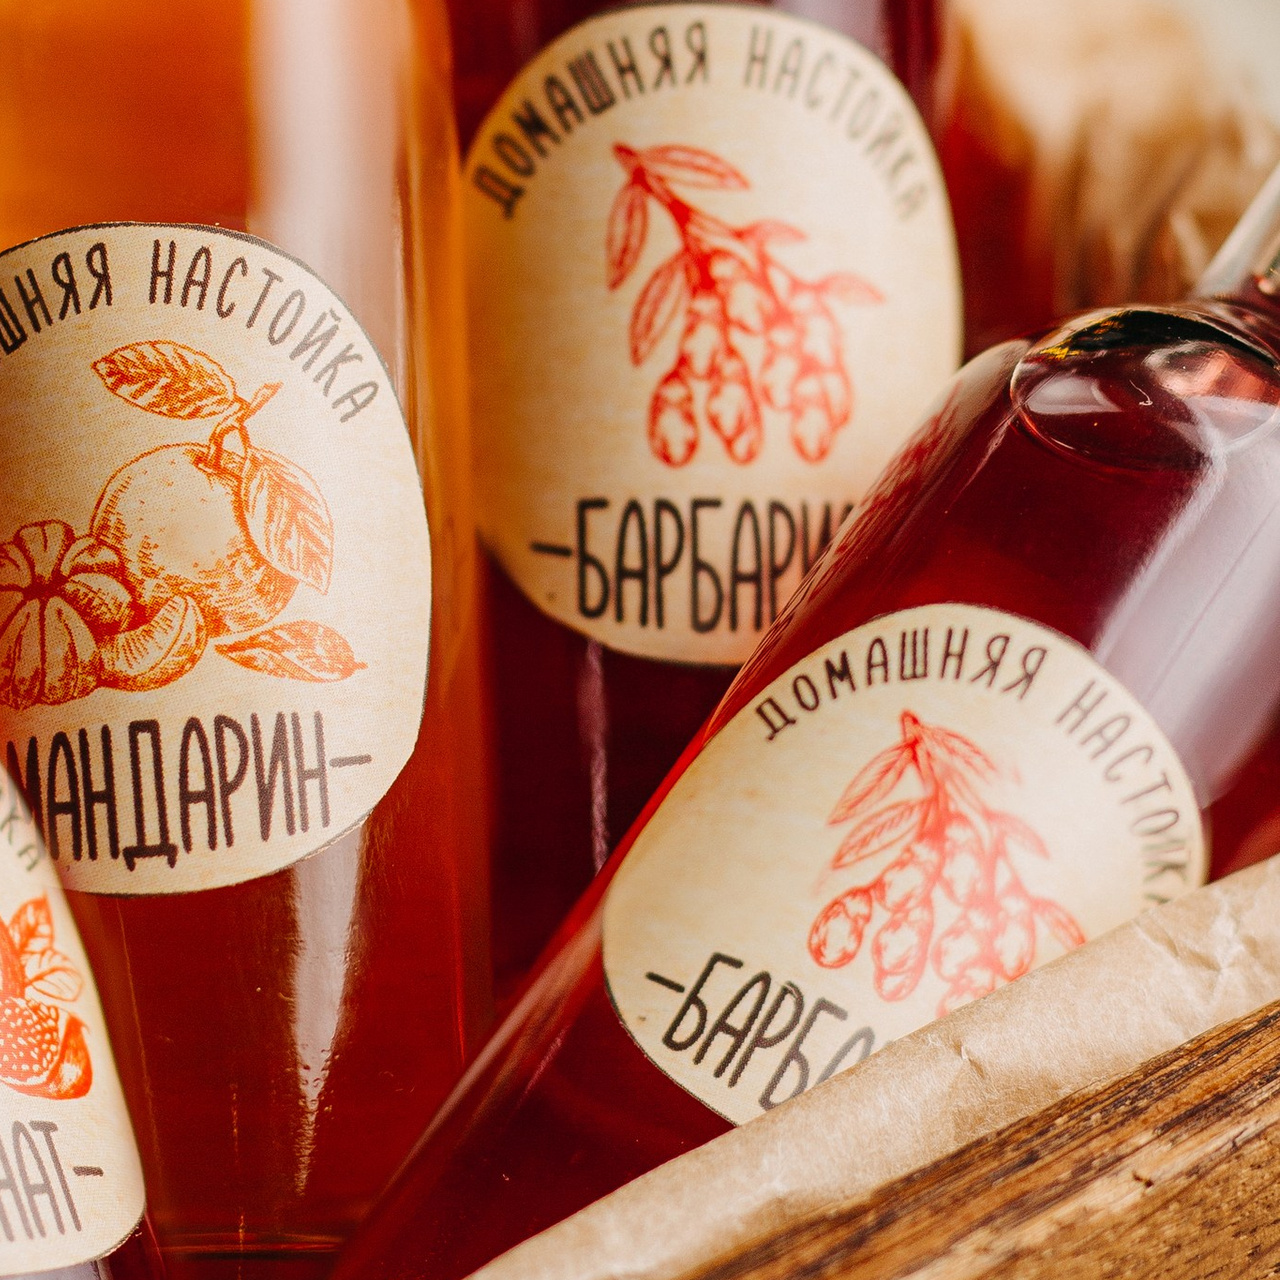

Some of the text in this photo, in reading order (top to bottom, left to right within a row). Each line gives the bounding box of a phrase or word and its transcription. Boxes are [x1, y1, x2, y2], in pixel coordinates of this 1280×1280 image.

[475, 20, 709, 220] ДОМАШНЯЯ
[148, 238, 380, 424] НАСТОЙКА
[753, 626, 1050, 742] ДОМАШНЯЯ
